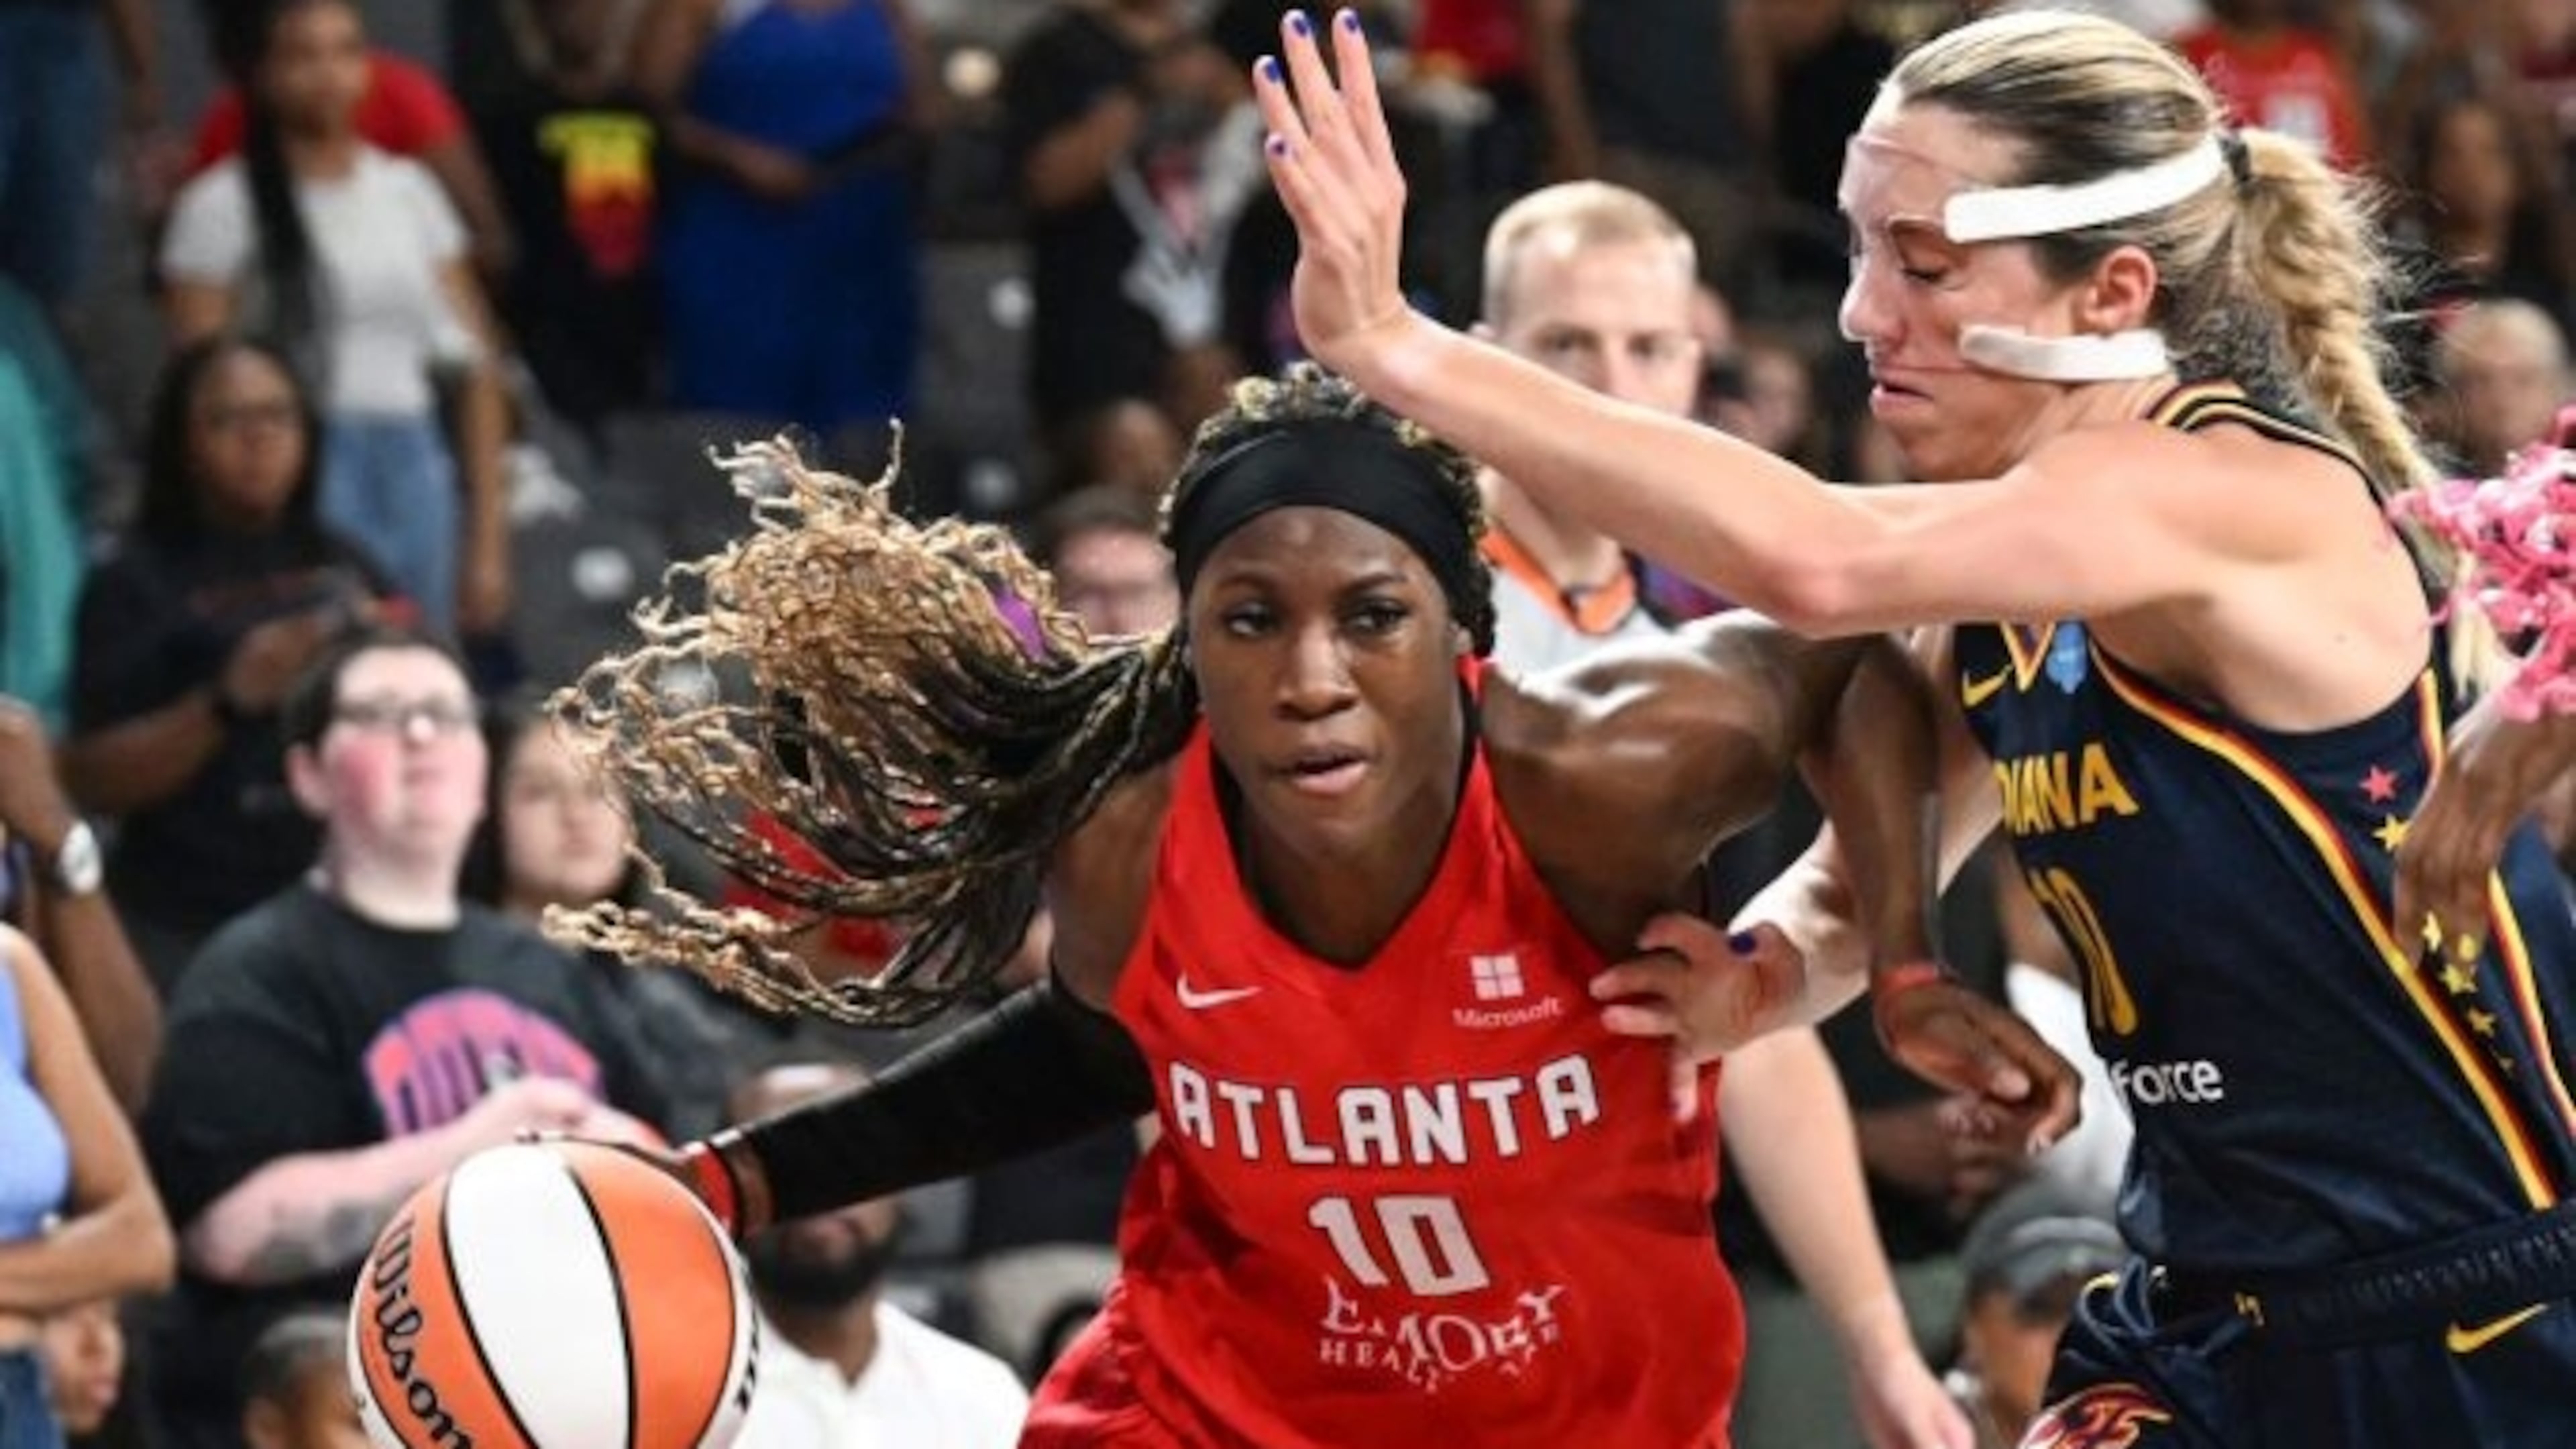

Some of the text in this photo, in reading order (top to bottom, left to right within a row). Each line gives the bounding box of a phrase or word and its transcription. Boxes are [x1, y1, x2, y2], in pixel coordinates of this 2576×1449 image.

[1452, 996, 1565, 1028] Microsoft
[1169, 1054, 1599, 1163] ATLANTA
[2111, 1060, 2224, 1104] force
[1309, 1196, 1490, 1295] 10
[373, 1214, 474, 1449] Wilson
